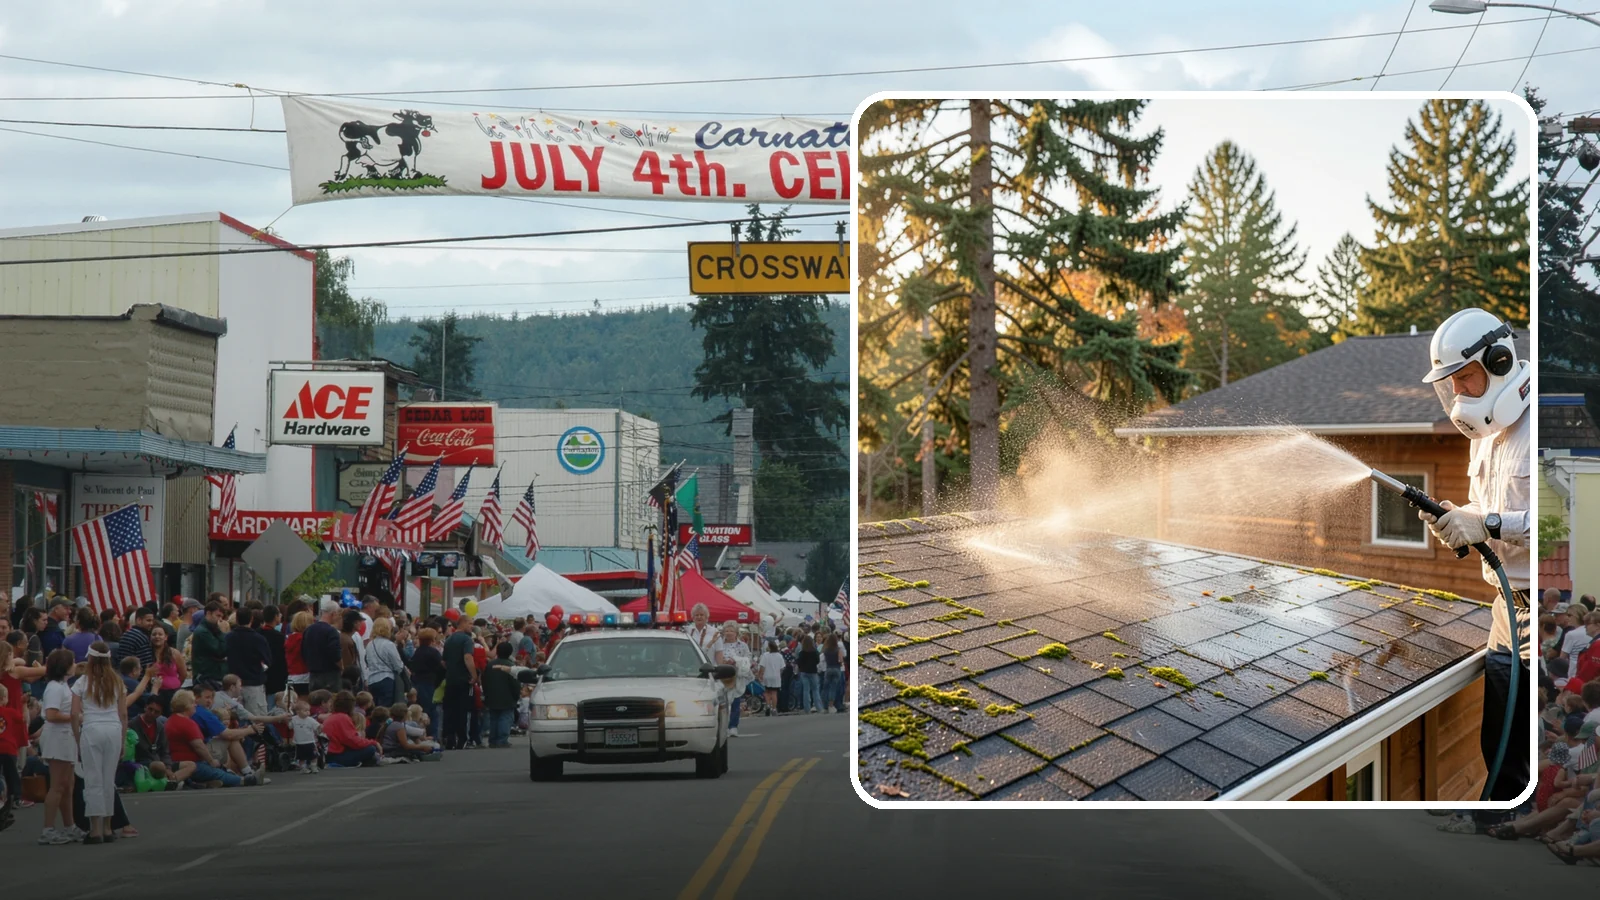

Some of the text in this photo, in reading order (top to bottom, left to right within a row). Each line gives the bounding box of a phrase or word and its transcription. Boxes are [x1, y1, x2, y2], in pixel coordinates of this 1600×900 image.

[695, 121, 850, 149] Carnat
[481, 141, 604, 192] JULY
[632, 150, 746, 197] 4th.
[697, 254, 850, 280] CROSSWA
[283, 380, 373, 419] ACE
[405, 409, 452, 421] CEDAR
[283, 421, 370, 436] Hardware
[416, 428, 477, 447] Coca-Cola
[353, 467, 384, 481] Simpl
[83, 485, 155, 495] St. Vincent de Paul
[213, 516, 331, 535] HARDARE
[688, 526, 741, 535] CRNATION
[699, 535, 730, 543] GLASS
